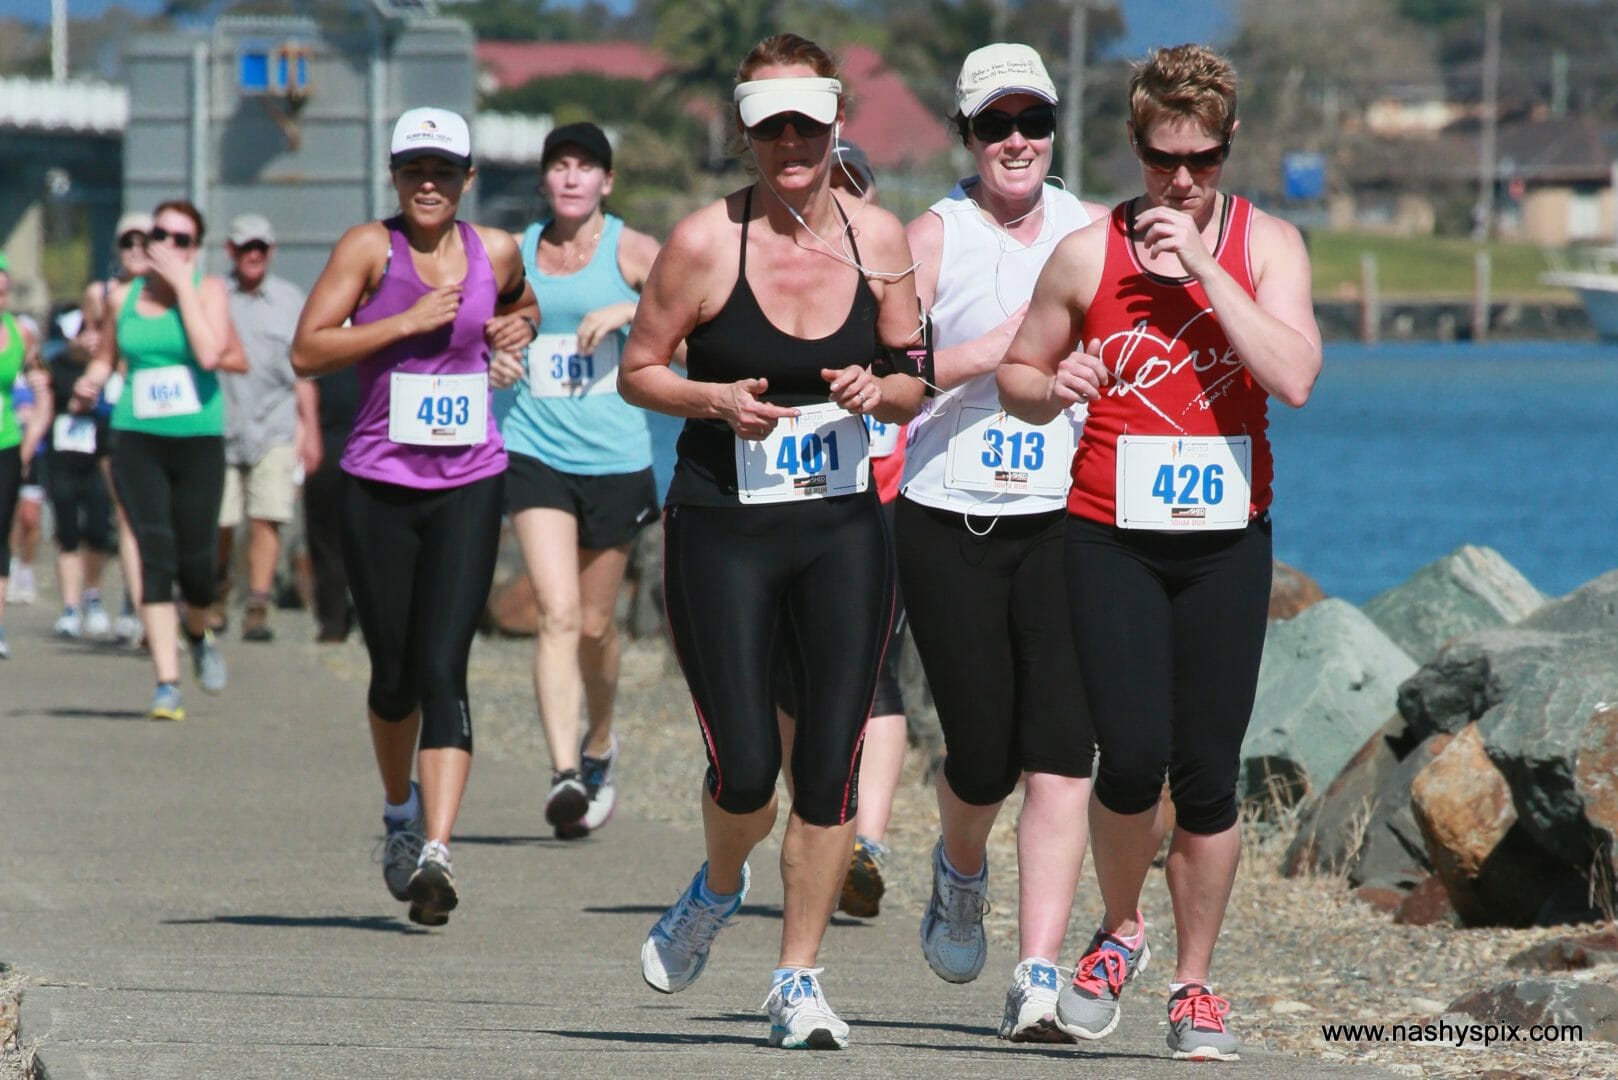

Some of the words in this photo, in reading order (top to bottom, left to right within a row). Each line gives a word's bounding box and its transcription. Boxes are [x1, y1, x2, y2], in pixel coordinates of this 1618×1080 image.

[551, 354, 593, 379] 361
[417, 396, 469, 425] 493
[776, 430, 839, 475] 401
[981, 428, 1045, 471] 313
[1152, 464, 1224, 505] 426
